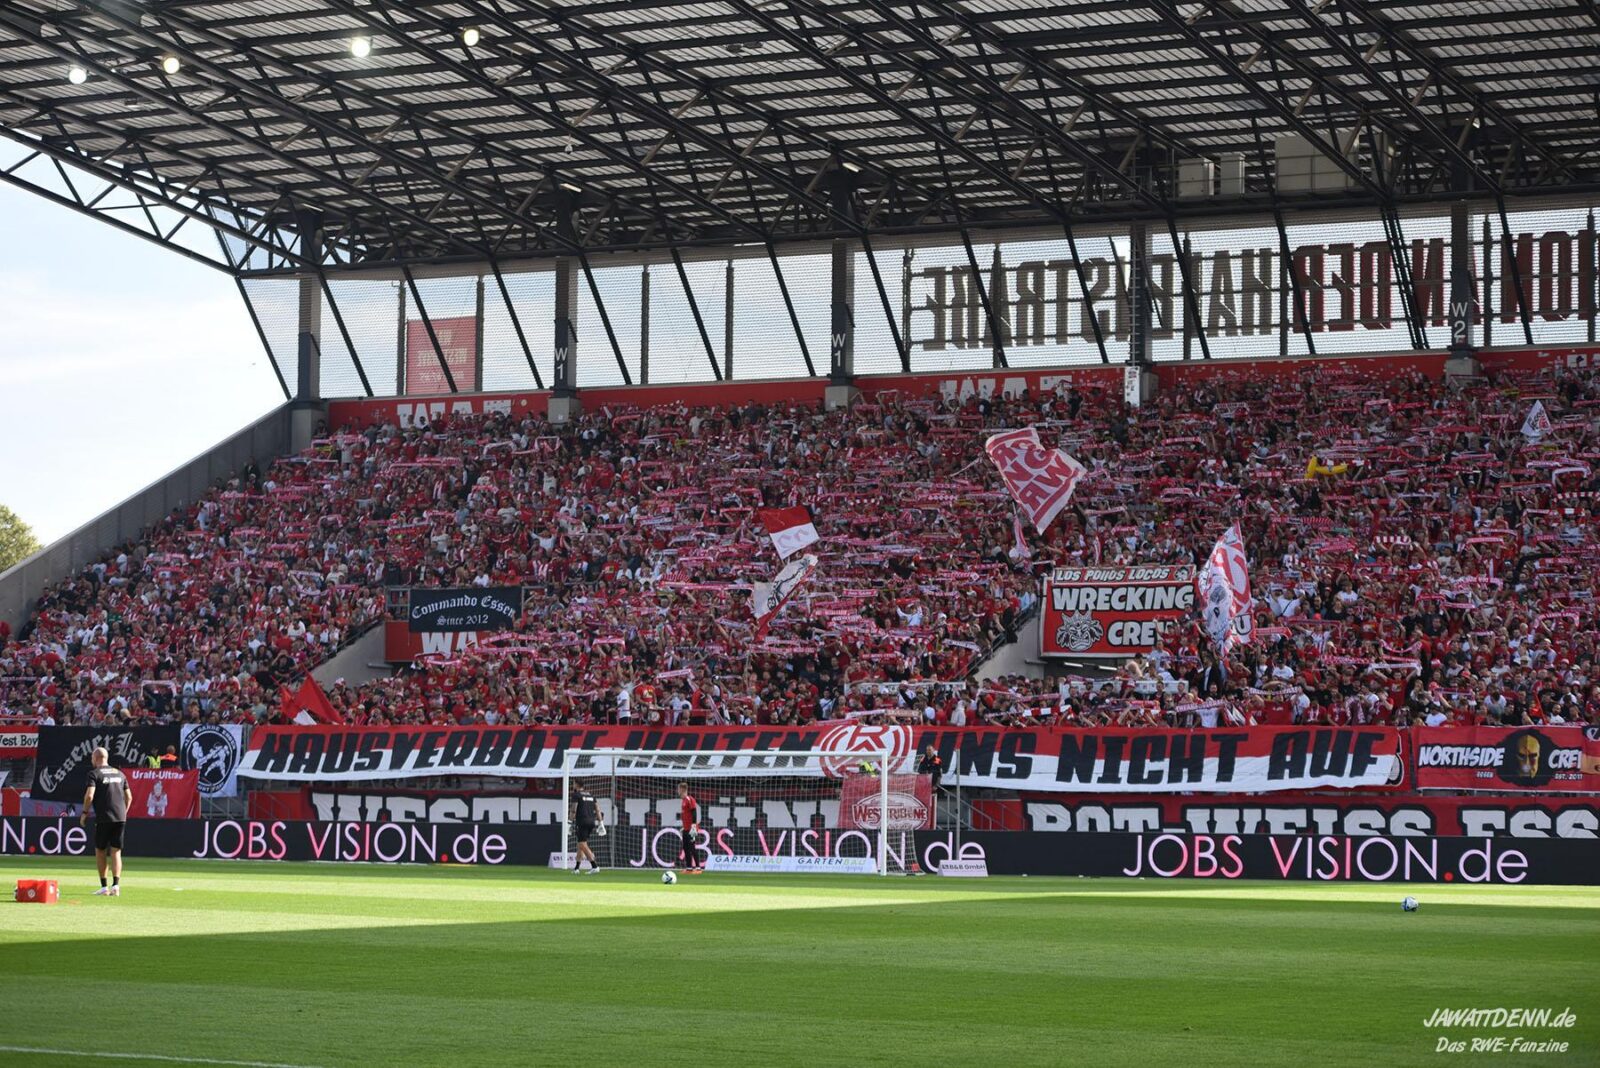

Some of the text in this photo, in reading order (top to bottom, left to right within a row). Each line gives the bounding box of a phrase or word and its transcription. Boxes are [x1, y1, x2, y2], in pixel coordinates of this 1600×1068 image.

[1057, 570, 1081, 581] LOS
[1128, 568, 1170, 580] LOCOS
[411, 594, 516, 619] Commando Essen
[1052, 585, 1195, 611] WRECKING
[436, 614, 489, 626] Since 2012
[39, 733, 114, 793] Essener
[252, 729, 608, 774] HAUSVERBOTE
[617, 730, 820, 770] HALTEN
[915, 731, 1037, 779] UNS
[1056, 732, 1248, 784] NICHT
[1267, 730, 1385, 780] AUF
[1418, 740, 1505, 767] NORTHSIDE
[193, 821, 507, 864] JOBS VISION.de
[630, 827, 986, 873] JOBS VISION.de
[1123, 834, 1529, 883] JOBS VISION.de
